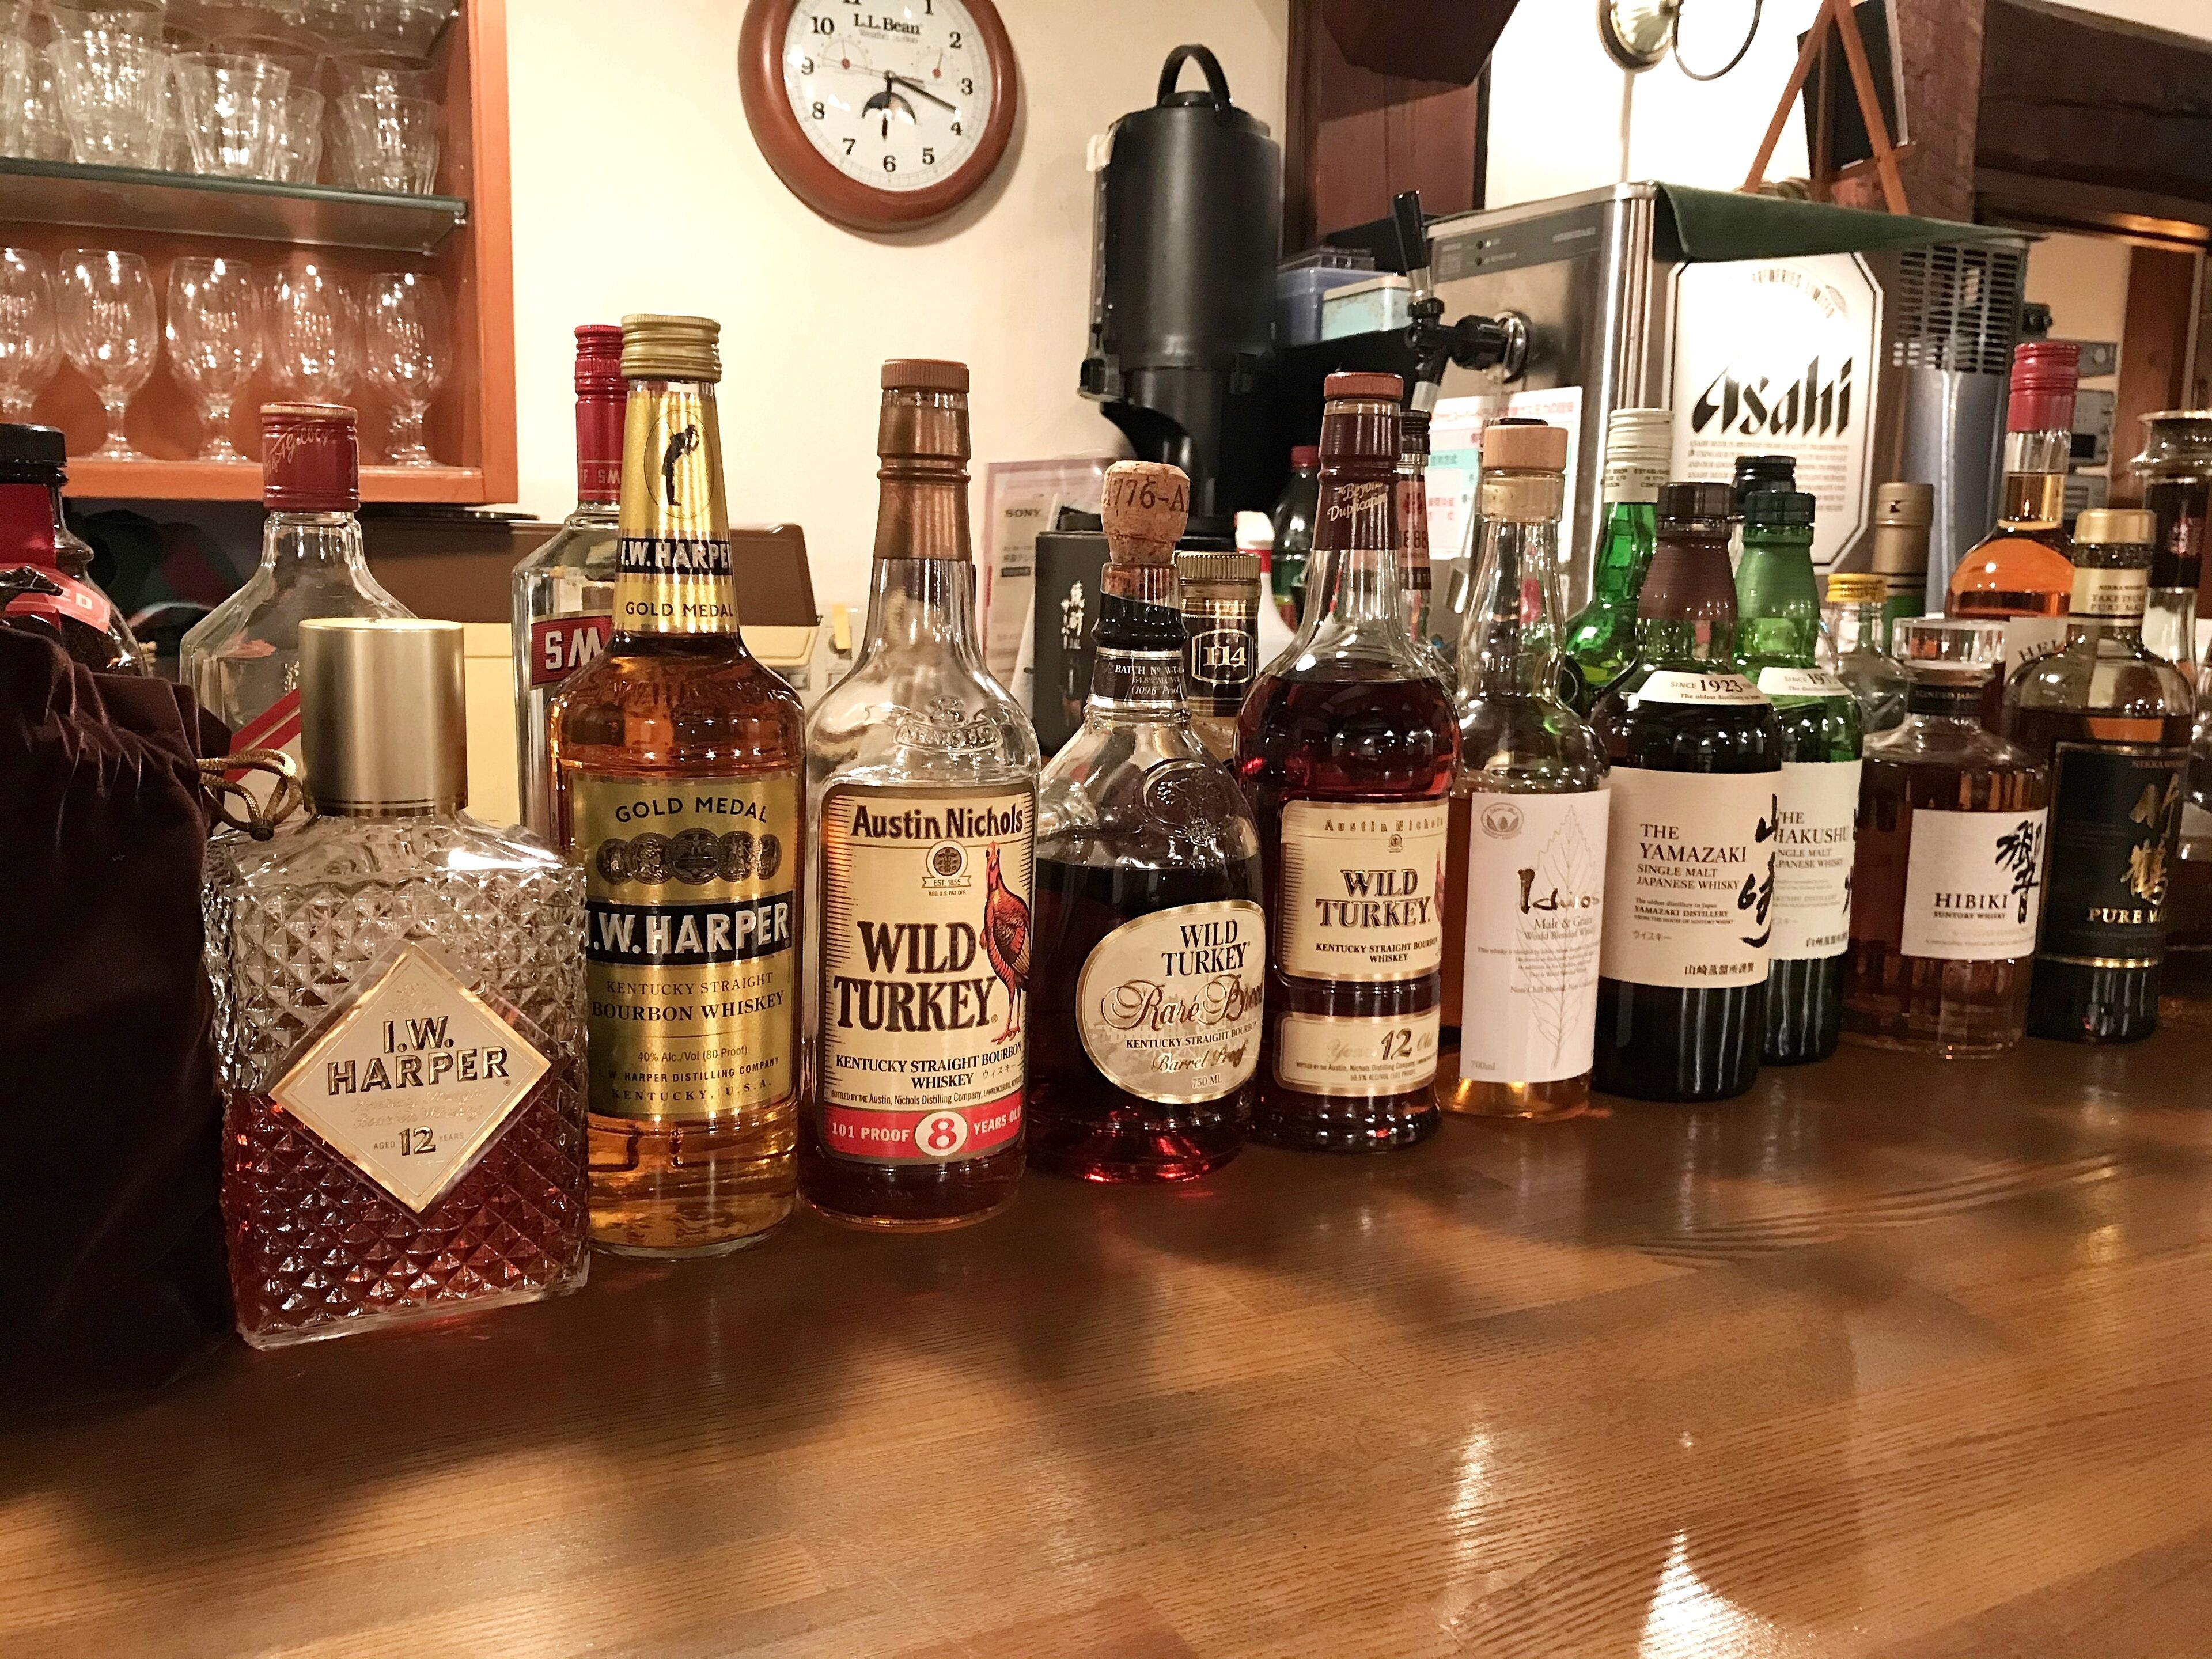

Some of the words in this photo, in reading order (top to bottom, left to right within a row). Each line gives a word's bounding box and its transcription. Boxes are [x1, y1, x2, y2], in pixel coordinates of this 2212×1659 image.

[812, 16, 834, 35] 10
[949, 32, 962, 49] 2
[801, 57, 814, 75] 9
[961, 78, 973, 96] 3
[812, 101, 825, 120] 8
[950, 121, 963, 136] 4
[842, 138, 855, 156] 7
[922, 147, 934, 165] 5
[883, 155, 896, 172] 6
[1691, 355, 1853, 438] Asahi
[1005, 508, 1042, 517] SONY
[626, 601, 673, 617] GOLD
[683, 603, 734, 618] MEDAL
[544, 626, 604, 670] SM
[1203, 646, 1247, 667] 114
[1115, 664, 1145, 675] BATCH
[1700, 679, 1743, 692] 1923
[615, 798, 683, 823] GOLD
[695, 797, 767, 823] MEDAL
[851, 805, 943, 839] Austin
[945, 803, 1023, 839] Nichols
[1324, 819, 1387, 832] Austin
[1640, 824, 1679, 840] THE
[1639, 842, 1747, 863] YAMAZAKI
[1808, 848, 1832, 857] MALT
[1637, 863, 1681, 876] SINGLE
[1685, 868, 1718, 878] MALT
[1340, 868, 1418, 897] WILD
[1637, 875, 1695, 889] JAPANESE
[1698, 880, 1740, 890] WHISKY
[1935, 892, 2008, 909] HIBIKI
[1315, 896, 1431, 929] TURKEY
[1635, 905, 1680, 916] YAMAZAKI
[1683, 910, 1729, 918] DISTILLERY
[2088, 908, 2142, 924] PURE
[1535, 918, 1558, 929] Malt
[1180, 919, 1238, 949] WILD
[856, 921, 977, 974] WILD
[1316, 942, 1366, 953] KENTUCKY
[1369, 942, 1412, 953] STRAIGHT
[1161, 941, 1248, 977] TURKEY
[1369, 952, 1408, 963] WHISKEY
[607, 980, 695, 995] KENTUCKY
[700, 972, 774, 995] STRAIGHT
[592, 1001, 694, 1021] BOURBON
[701, 990, 784, 1020] WHISKEY
[833, 975, 998, 1032] TURKEY
[1101, 979, 1201, 1031] Rare
[1126, 1037, 1183, 1048] KENTUCKY
[1185, 1031, 1230, 1046] STRAIGHT
[1381, 1028, 1413, 1060] 12
[638, 1052, 658, 1062] 40%
[703, 1050, 718, 1061] (80
[721, 1045, 748, 1058] Proof)
[836, 1054, 907, 1073] KENTUCKY
[910, 1055, 979, 1073] STRAIGHT
[981, 1040, 1022, 1066] BOURBON
[1150, 1050, 1210, 1073] Barrel
[327, 1046, 510, 1096] HARPER
[624, 1072, 668, 1082] HARPER
[672, 1069, 734, 1082] DISTILLING
[739, 1056, 779, 1075] COMPANY
[725, 1078, 772, 1096] U.S.A.
[911, 1073, 974, 1089] WHISKEY
[1192, 1077, 1207, 1088] 750
[1210, 1074, 1222, 1085] ML
[851, 1093, 858, 1101] BY
[859, 1094, 868, 1103] THE
[869, 1093, 893, 1106] Austin,
[895, 1095, 920, 1105] Nichols
[922, 1094, 952, 1105] Distilling
[953, 1092, 983, 1103] Company,
[832, 1122, 854, 1139] 101
[861, 1127, 910, 1142] PROOF
[927, 1118, 957, 1150] 8
[973, 1113, 1007, 1137] YEARS
[1009, 1104, 1022, 1123] OLD
[374, 1141, 396, 1150] AGED
[397, 1126, 437, 1156] 12
[438, 1132, 464, 1142] YEARS
